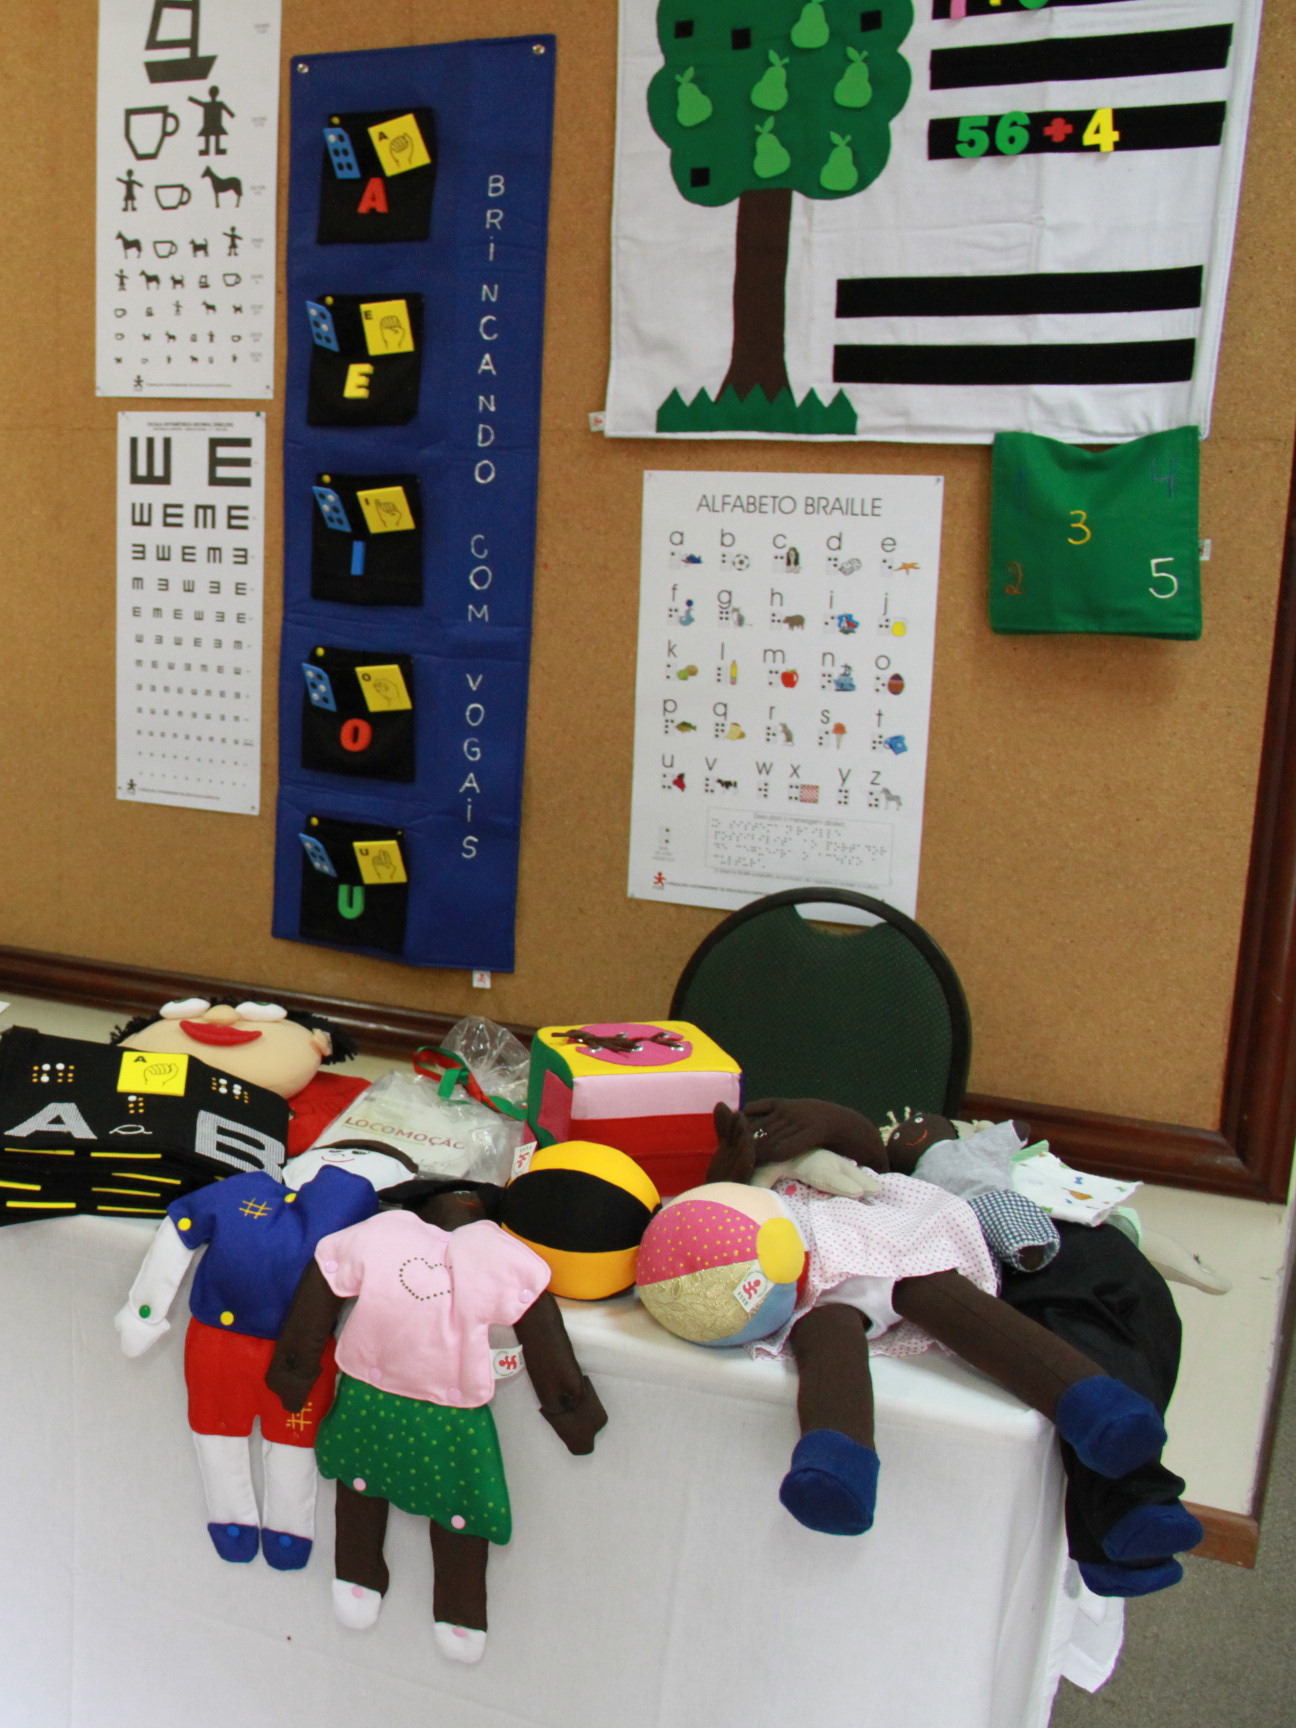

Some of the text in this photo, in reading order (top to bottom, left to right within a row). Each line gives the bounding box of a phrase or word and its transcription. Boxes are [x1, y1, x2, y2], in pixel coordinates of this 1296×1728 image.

[377, 131, 389, 141] A
[955, 111, 1031, 158] 56
[1082, 107, 1120, 152] 4
[356, 177, 389, 213] A
[364, 310, 373, 320] E
[343, 362, 374, 398] E
[697, 494, 883, 518] ALFABETO BRAILLE
[669, 529, 897, 553] a b c d e
[1067, 510, 1092, 545] 3
[351, 540, 366, 576] I
[467, 534, 492, 623] COM
[1149, 557, 1179, 599] 5
[671, 584, 679, 602] f
[717, 589, 732, 609] g
[770, 588, 783, 607] h
[667, 640, 678, 658] k
[763, 648, 786, 664] m
[822, 650, 835, 667] n
[875, 655, 891, 671] o
[663, 697, 885, 728] p q r s t
[340, 718, 373, 752] O
[661, 753, 881, 787] u v w x y z
[337, 884, 365, 919] U
[133, 1055, 148, 1064] A
[3, 1102, 98, 1140] A
[195, 1109, 286, 1185] B
